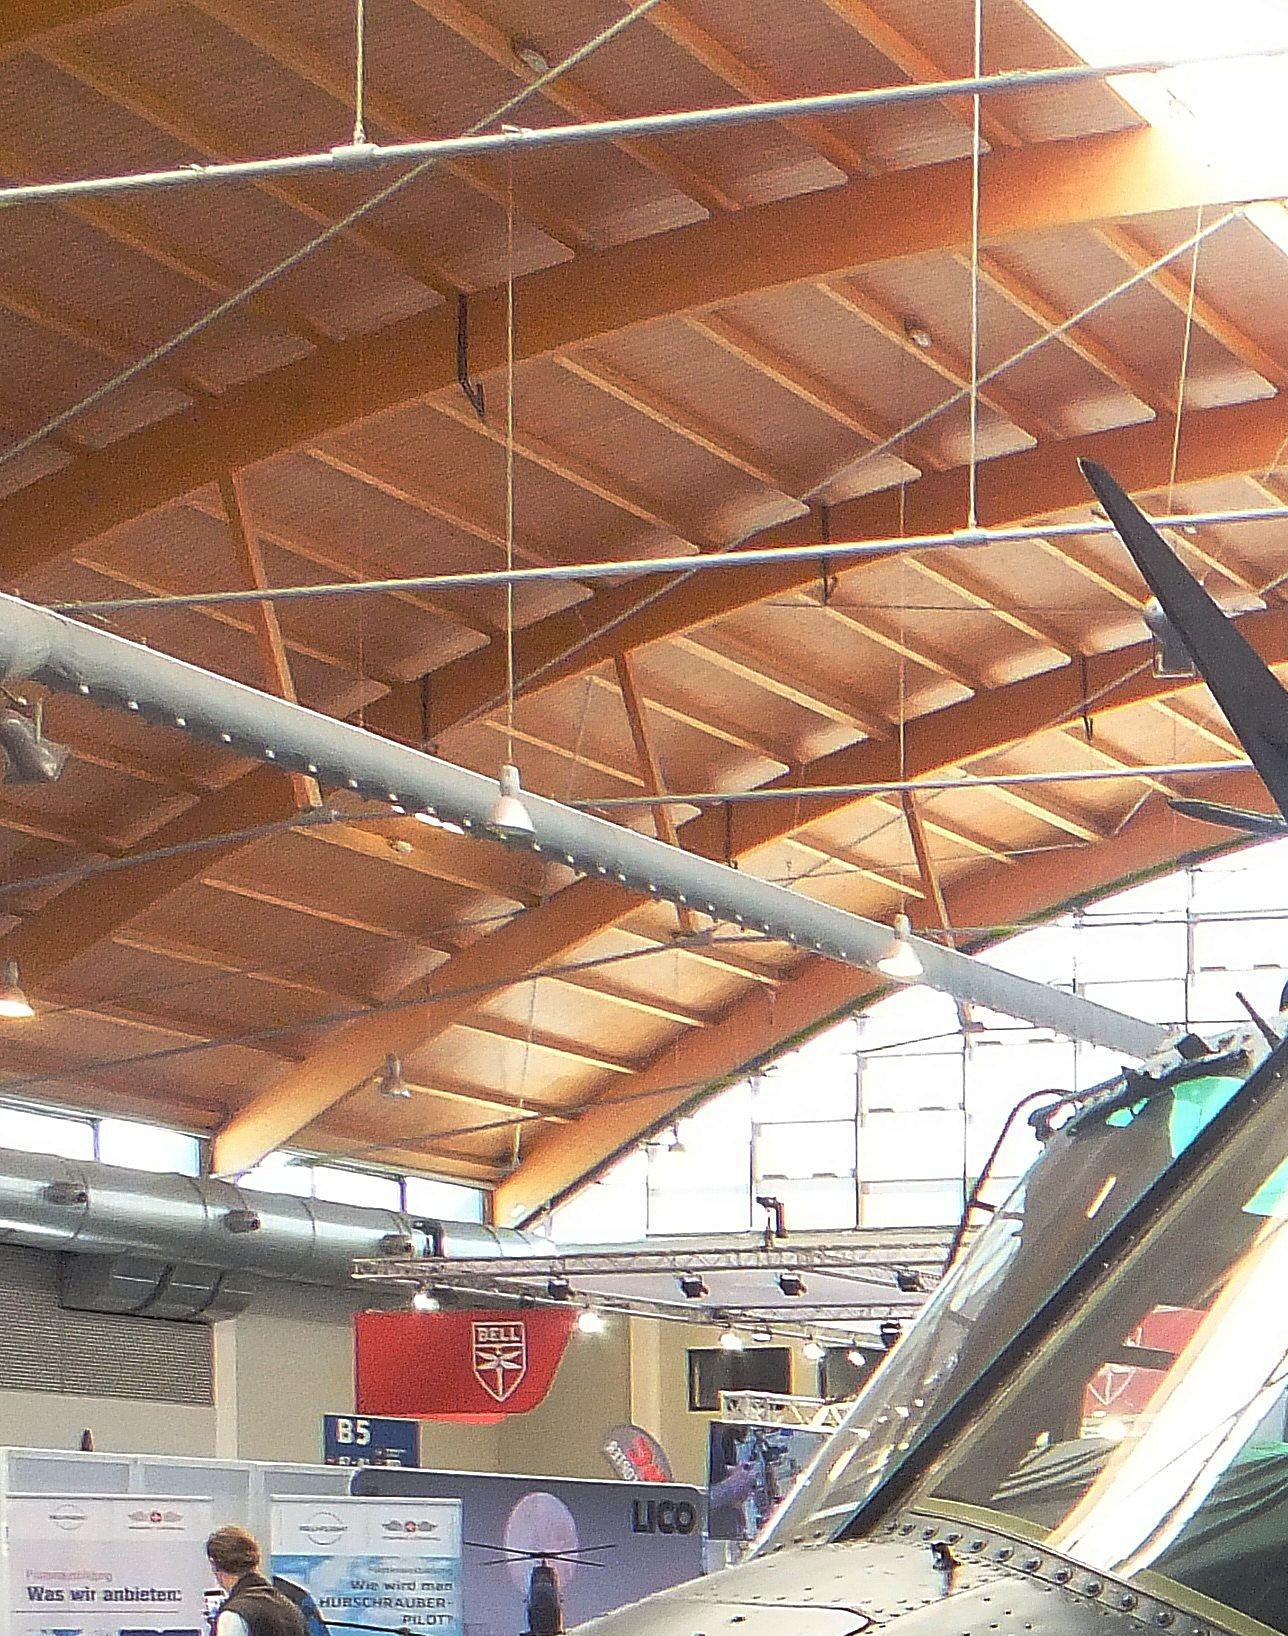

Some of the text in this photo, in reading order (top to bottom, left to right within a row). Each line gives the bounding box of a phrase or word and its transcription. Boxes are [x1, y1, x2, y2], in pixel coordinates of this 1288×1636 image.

[476, 1327, 520, 1342] BELL
[337, 1418, 371, 1446] B5
[632, 1499, 695, 1535] LICO
[27, 1586, 64, 1601] Was
[70, 1587, 96, 1601] wir
